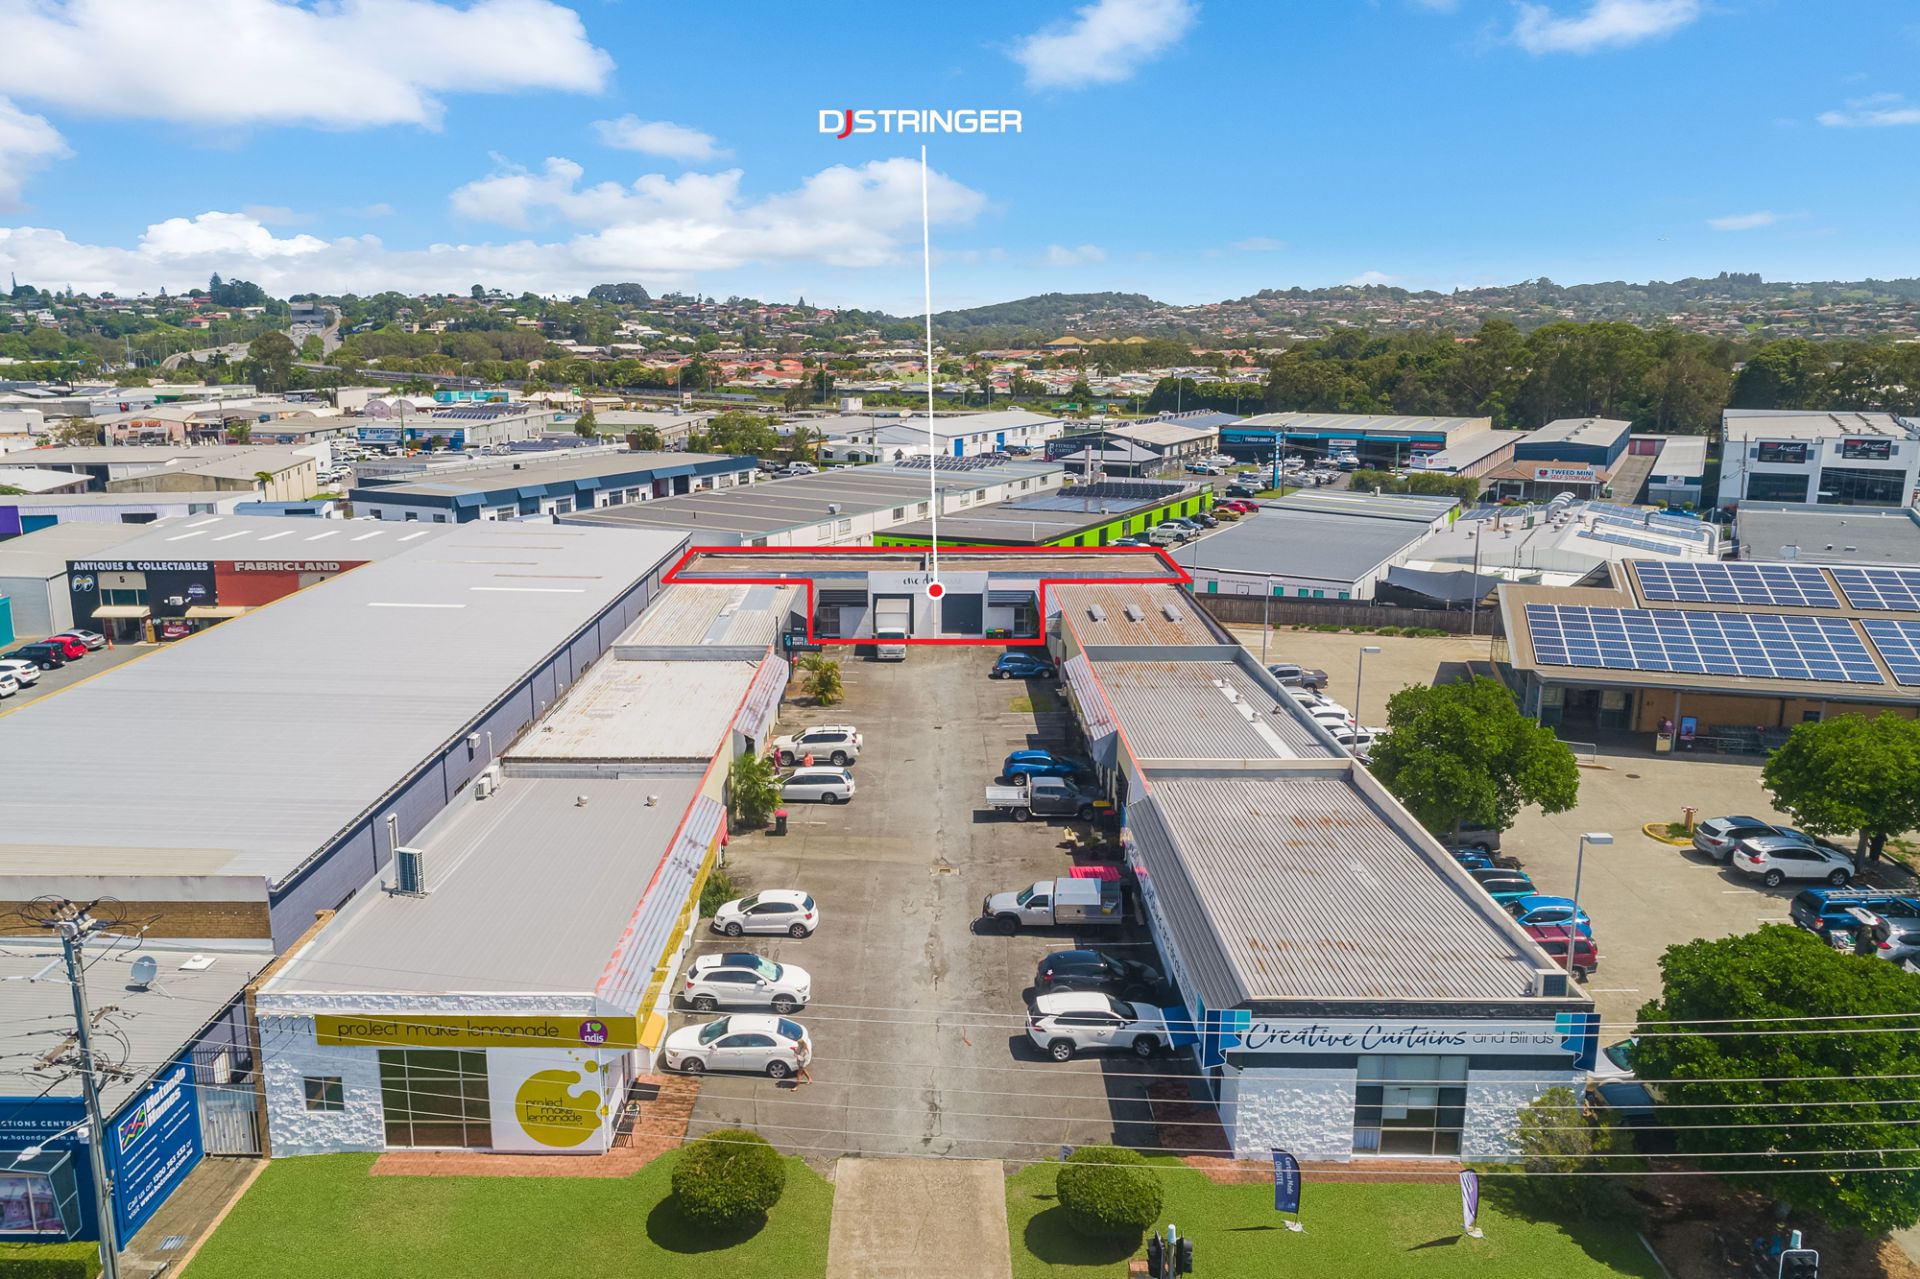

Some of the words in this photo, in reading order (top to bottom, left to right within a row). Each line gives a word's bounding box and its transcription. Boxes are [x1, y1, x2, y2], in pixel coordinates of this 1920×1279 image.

[73, 562, 123, 571] ANTIQUES
[127, 562, 135, 571] &
[137, 562, 209, 571] COLLECTABLES
[234, 561, 340, 571] FABRICLAND
[467, 1020, 560, 1037] lemonade
[1245, 1022, 1358, 1050] Creative
[1361, 1024, 1467, 1050] Curtains
[1472, 1031, 1506, 1044] and
[1509, 1031, 1554, 1044] Blinds
[584, 1033, 604, 1043] ndis
[145, 1067, 186, 1113] Hotondo
[147, 1087, 181, 1127] Homes
[127, 1195, 140, 1211] Call
